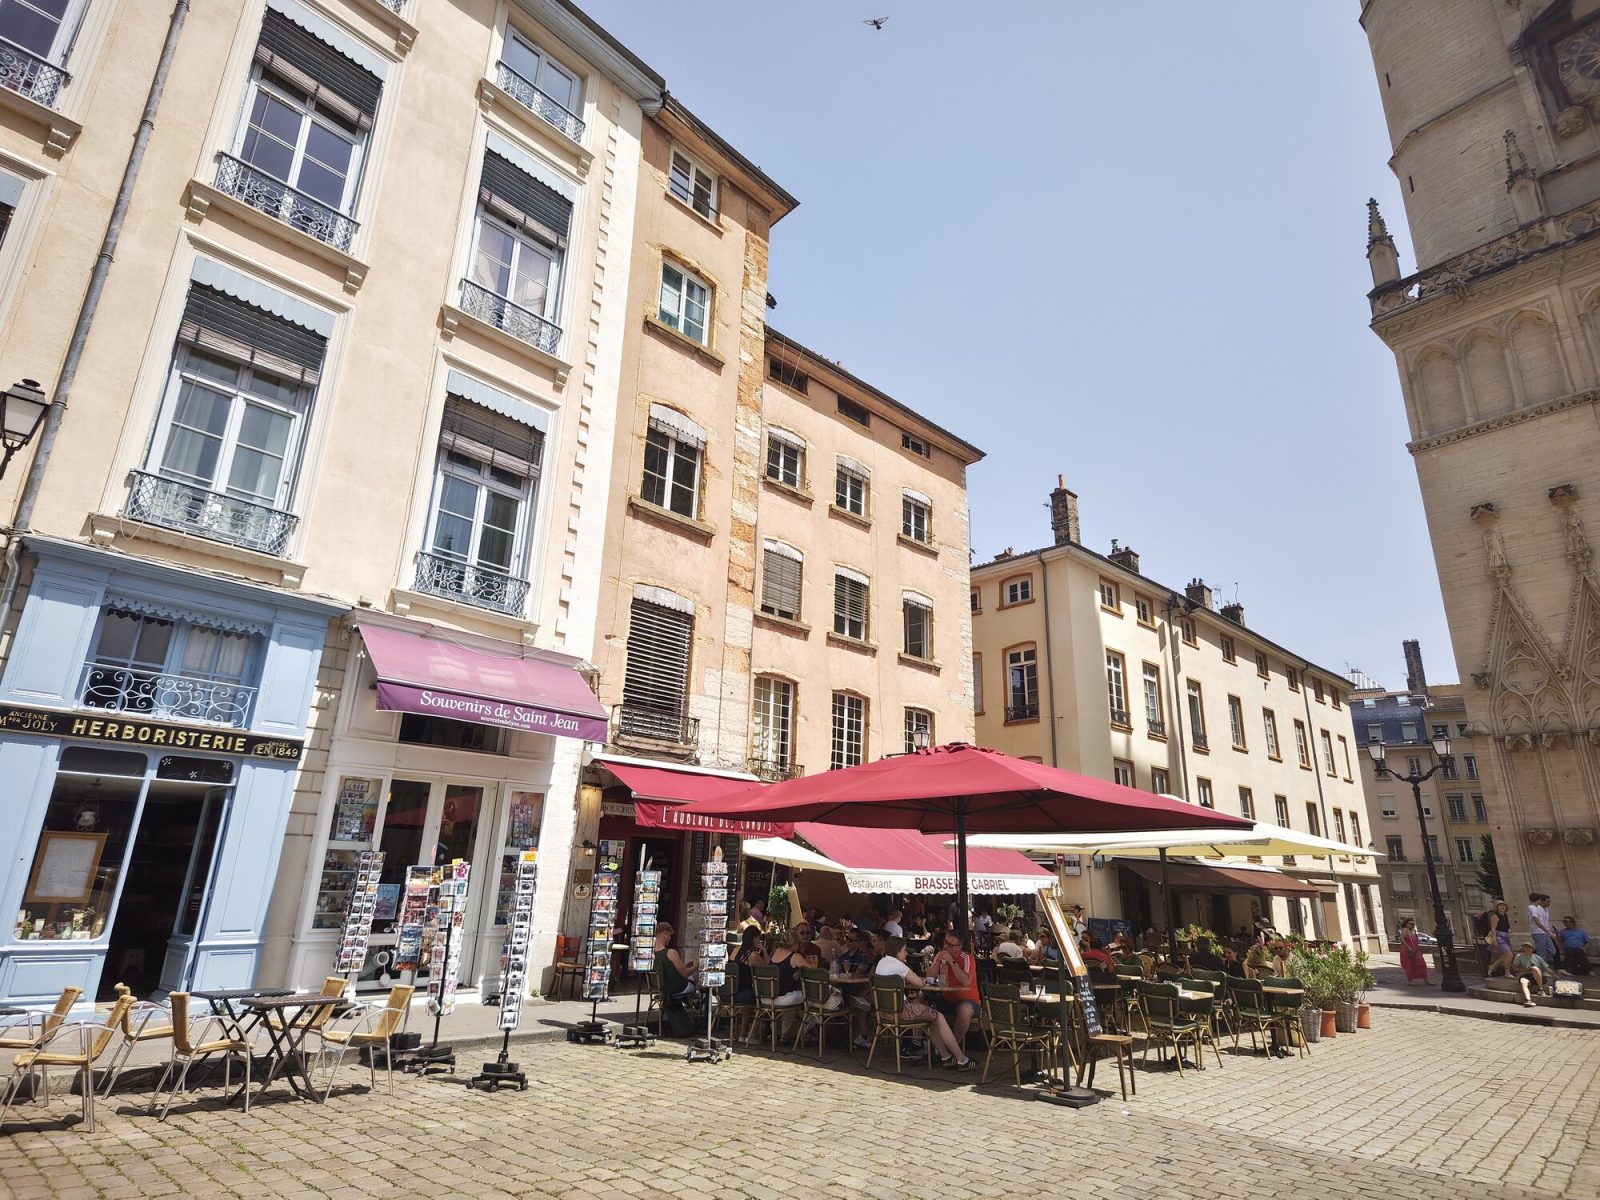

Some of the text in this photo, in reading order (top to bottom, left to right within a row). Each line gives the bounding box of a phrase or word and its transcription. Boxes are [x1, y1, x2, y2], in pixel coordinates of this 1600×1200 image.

[8, 710, 49, 721] ANCIENNE
[420, 691, 579, 731] Souvenirs de Saint Jean
[22, 719, 59, 731] JOLY
[71, 718, 248, 752] HERBORISTERIE
[256, 744, 299, 758] EN 1849
[847, 875, 1010, 891] Restaurant BRASSER GABRIEL
